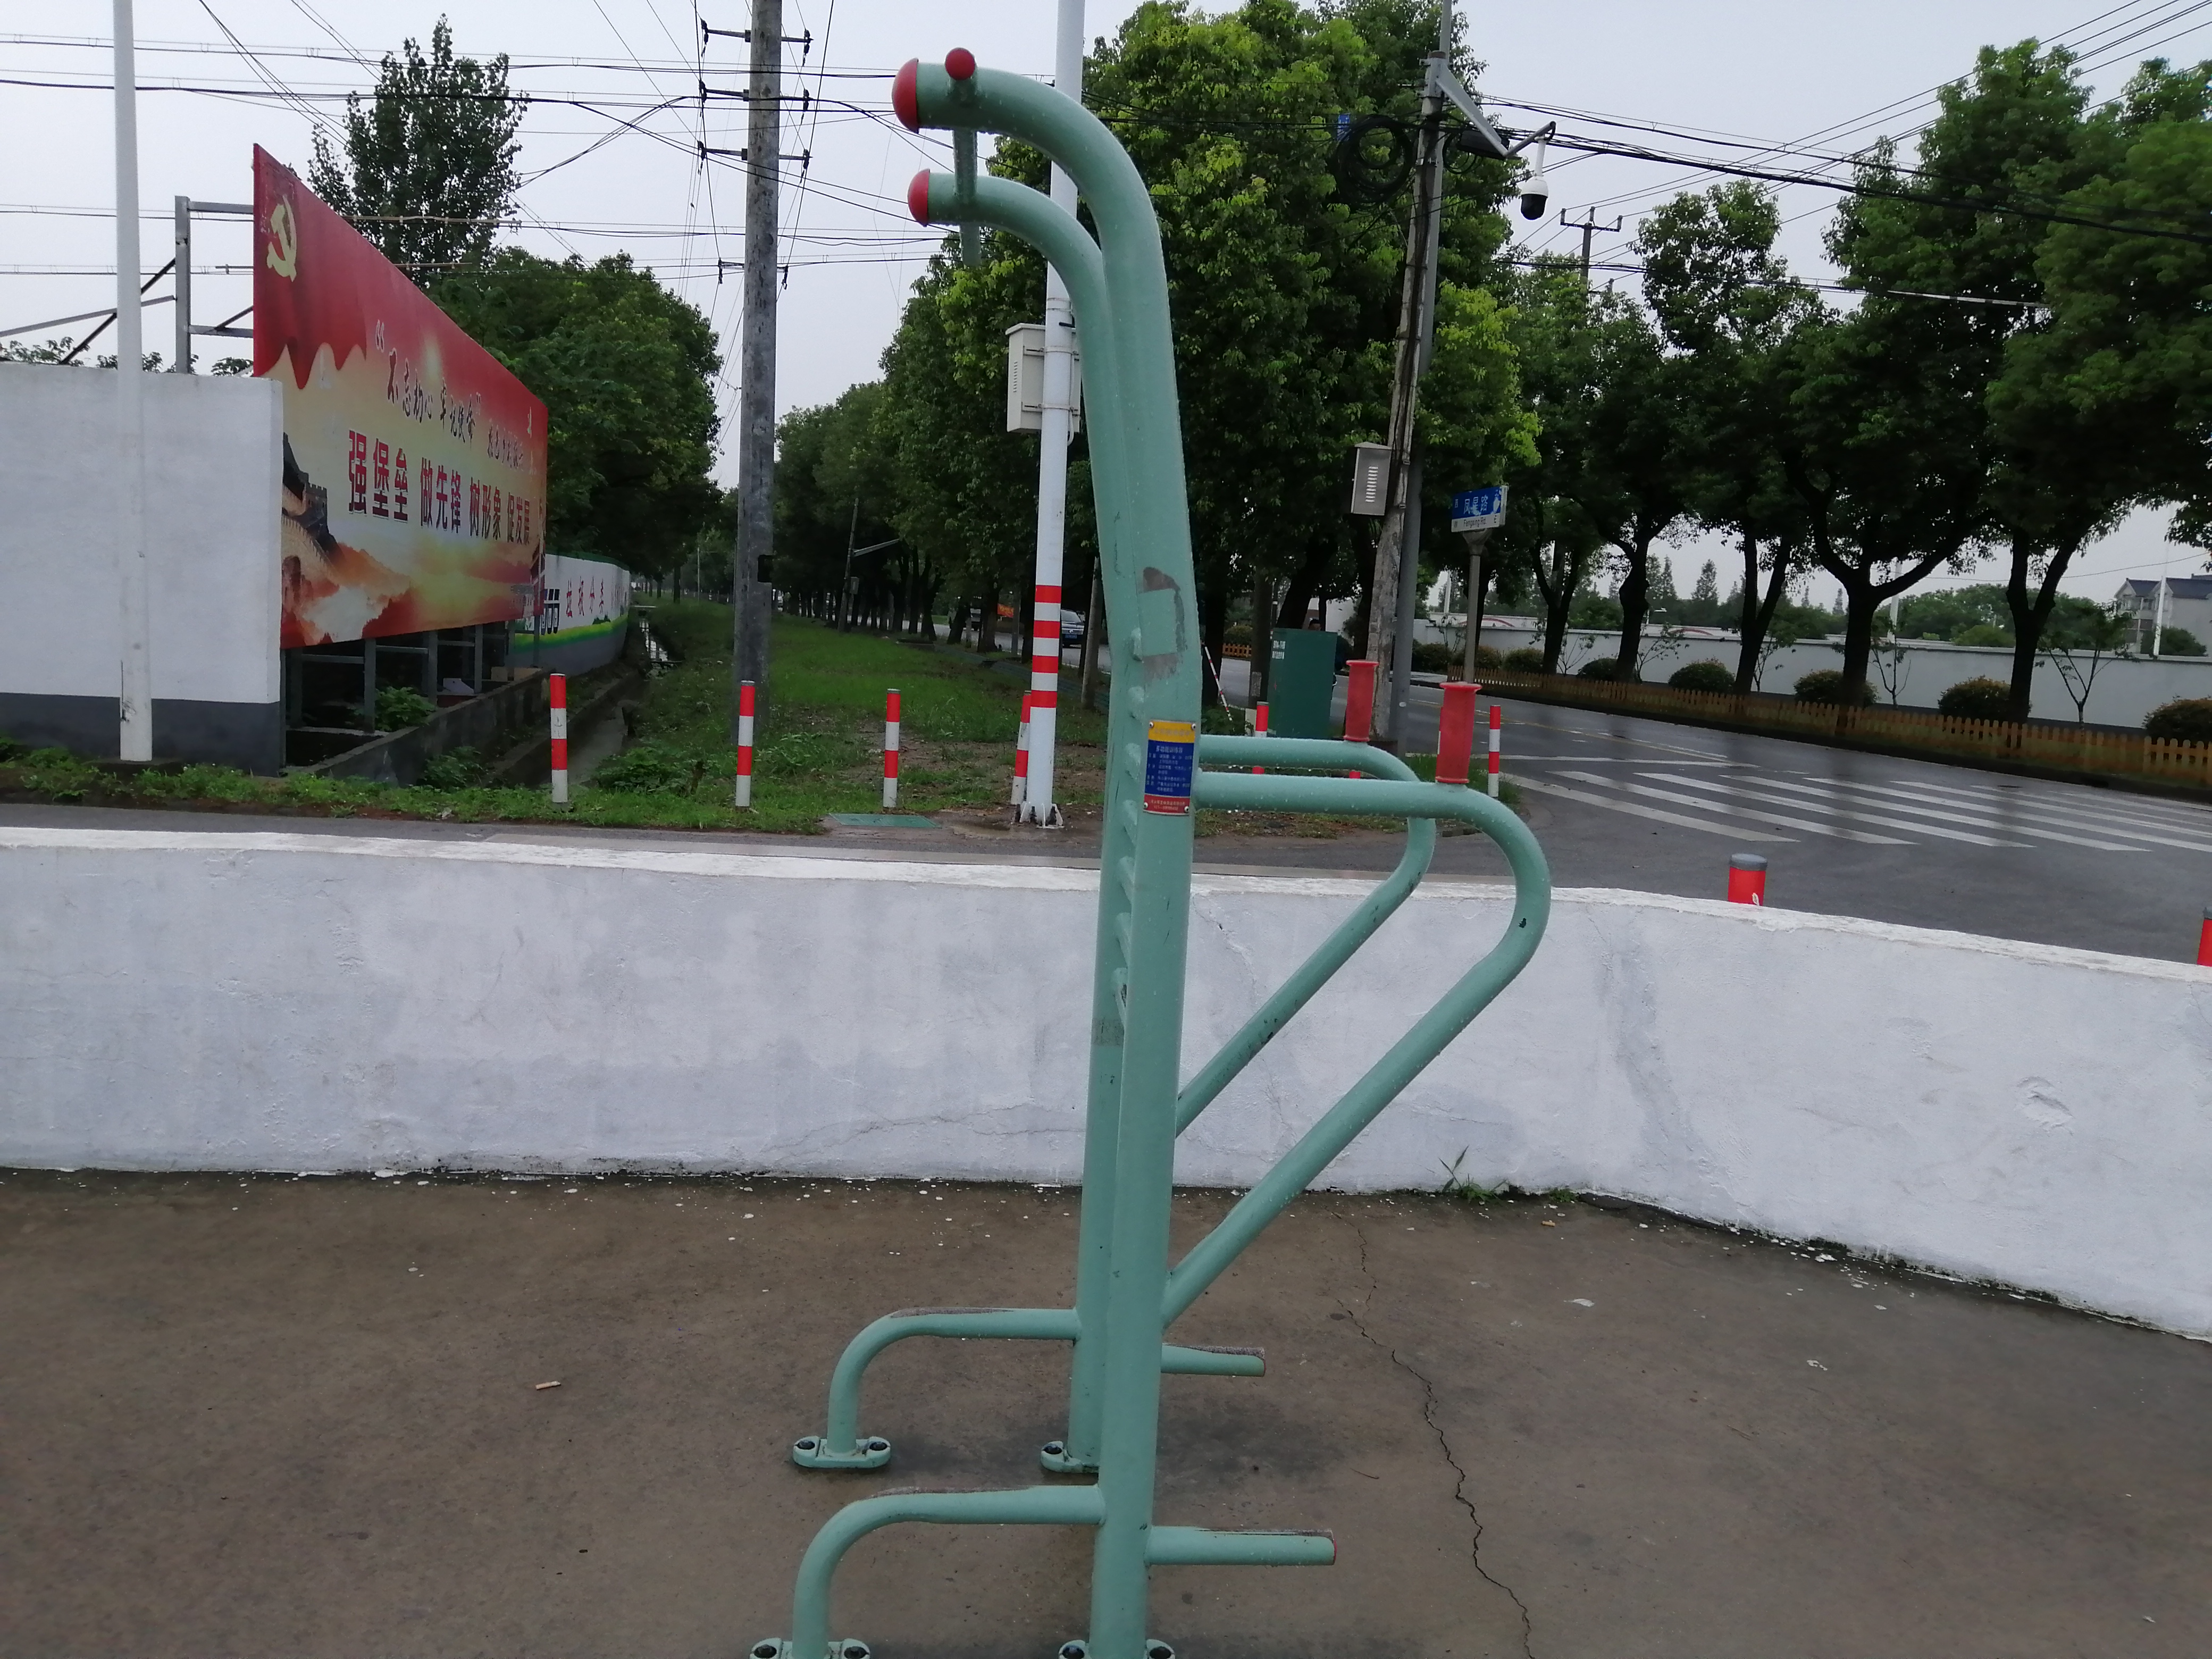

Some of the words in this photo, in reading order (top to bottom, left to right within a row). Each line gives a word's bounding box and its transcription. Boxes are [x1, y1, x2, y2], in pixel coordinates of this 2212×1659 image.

[348, 430, 409, 523] 强堡垒
[420, 456, 461, 534] 做先锋
[470, 476, 501, 541] 树形象
[507, 491, 530, 544] 促发展
